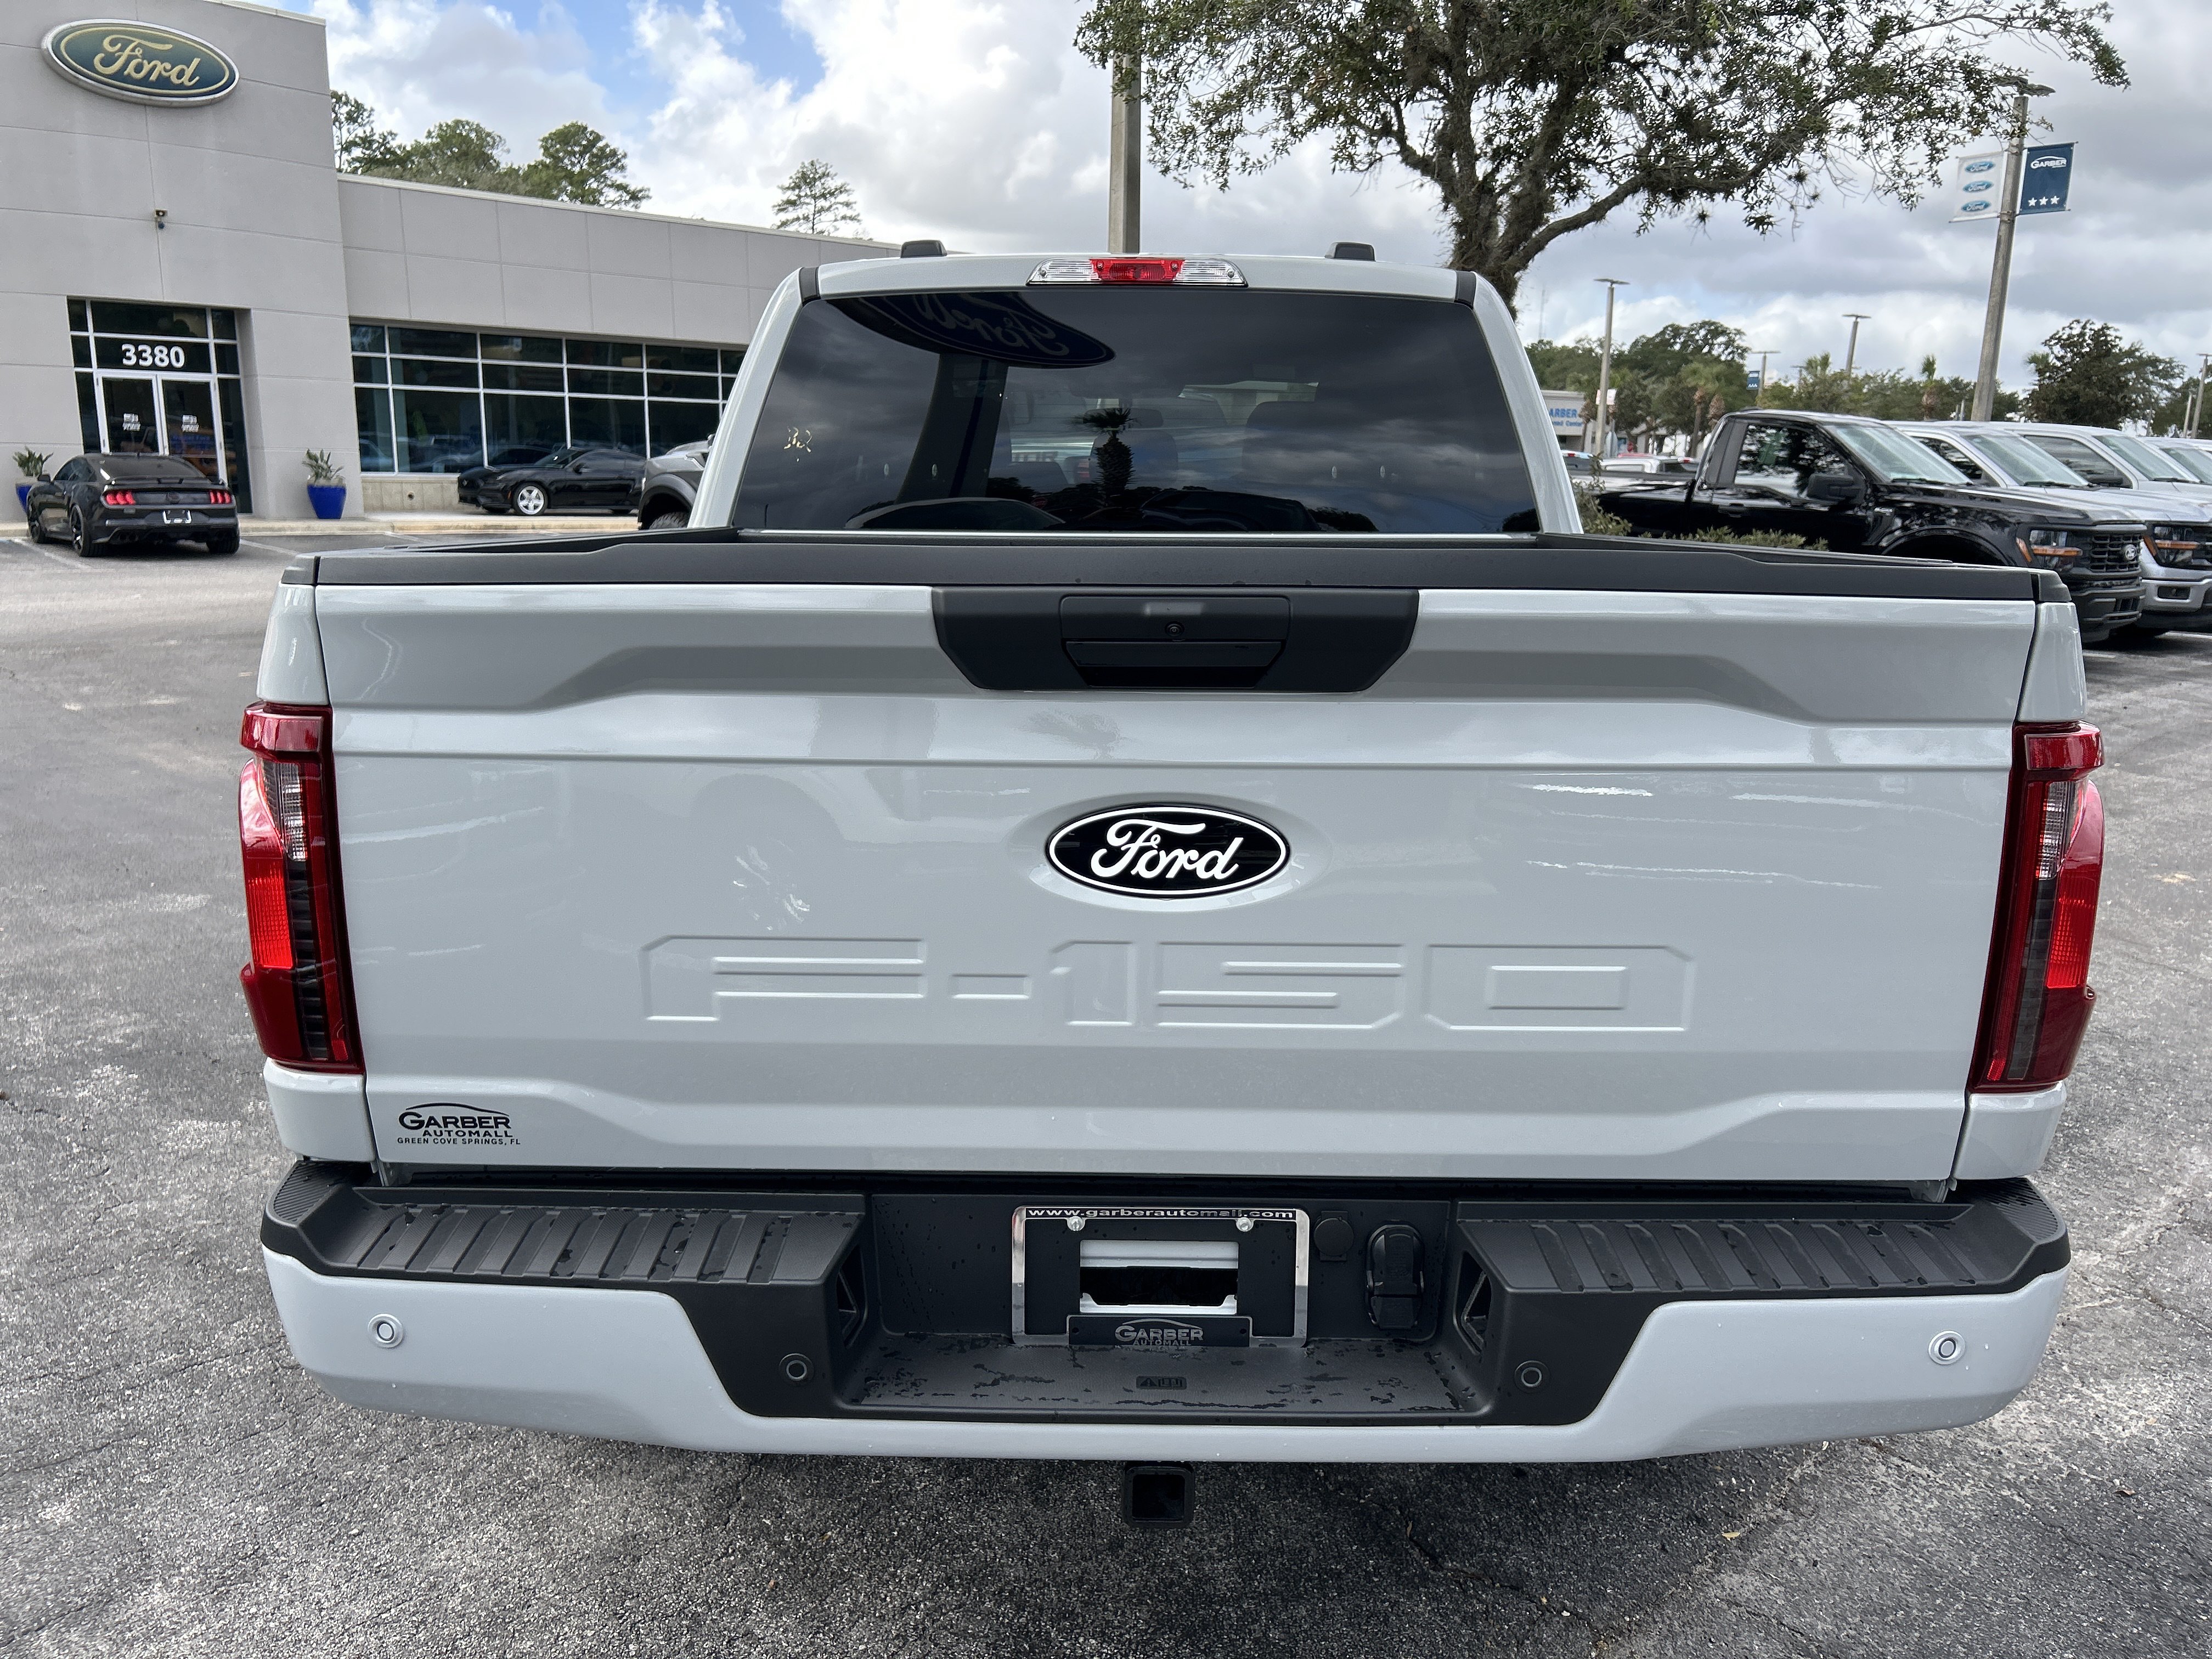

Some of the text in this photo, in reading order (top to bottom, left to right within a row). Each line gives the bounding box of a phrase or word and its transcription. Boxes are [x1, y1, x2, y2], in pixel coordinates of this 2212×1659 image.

[93, 34, 200, 87] Ford
[2030, 159, 2067, 169] GARBER
[121, 343, 185, 368] 3380
[1549, 408, 1577, 417] ARBER
[1090, 819, 1244, 879] Ford
[638, 934, 1696, 1032] F-150
[398, 1111, 512, 1130] GARBER
[1028, 1209, 1293, 1218] www.garberautomall.com
[1115, 1325, 1204, 1342] GARBER
